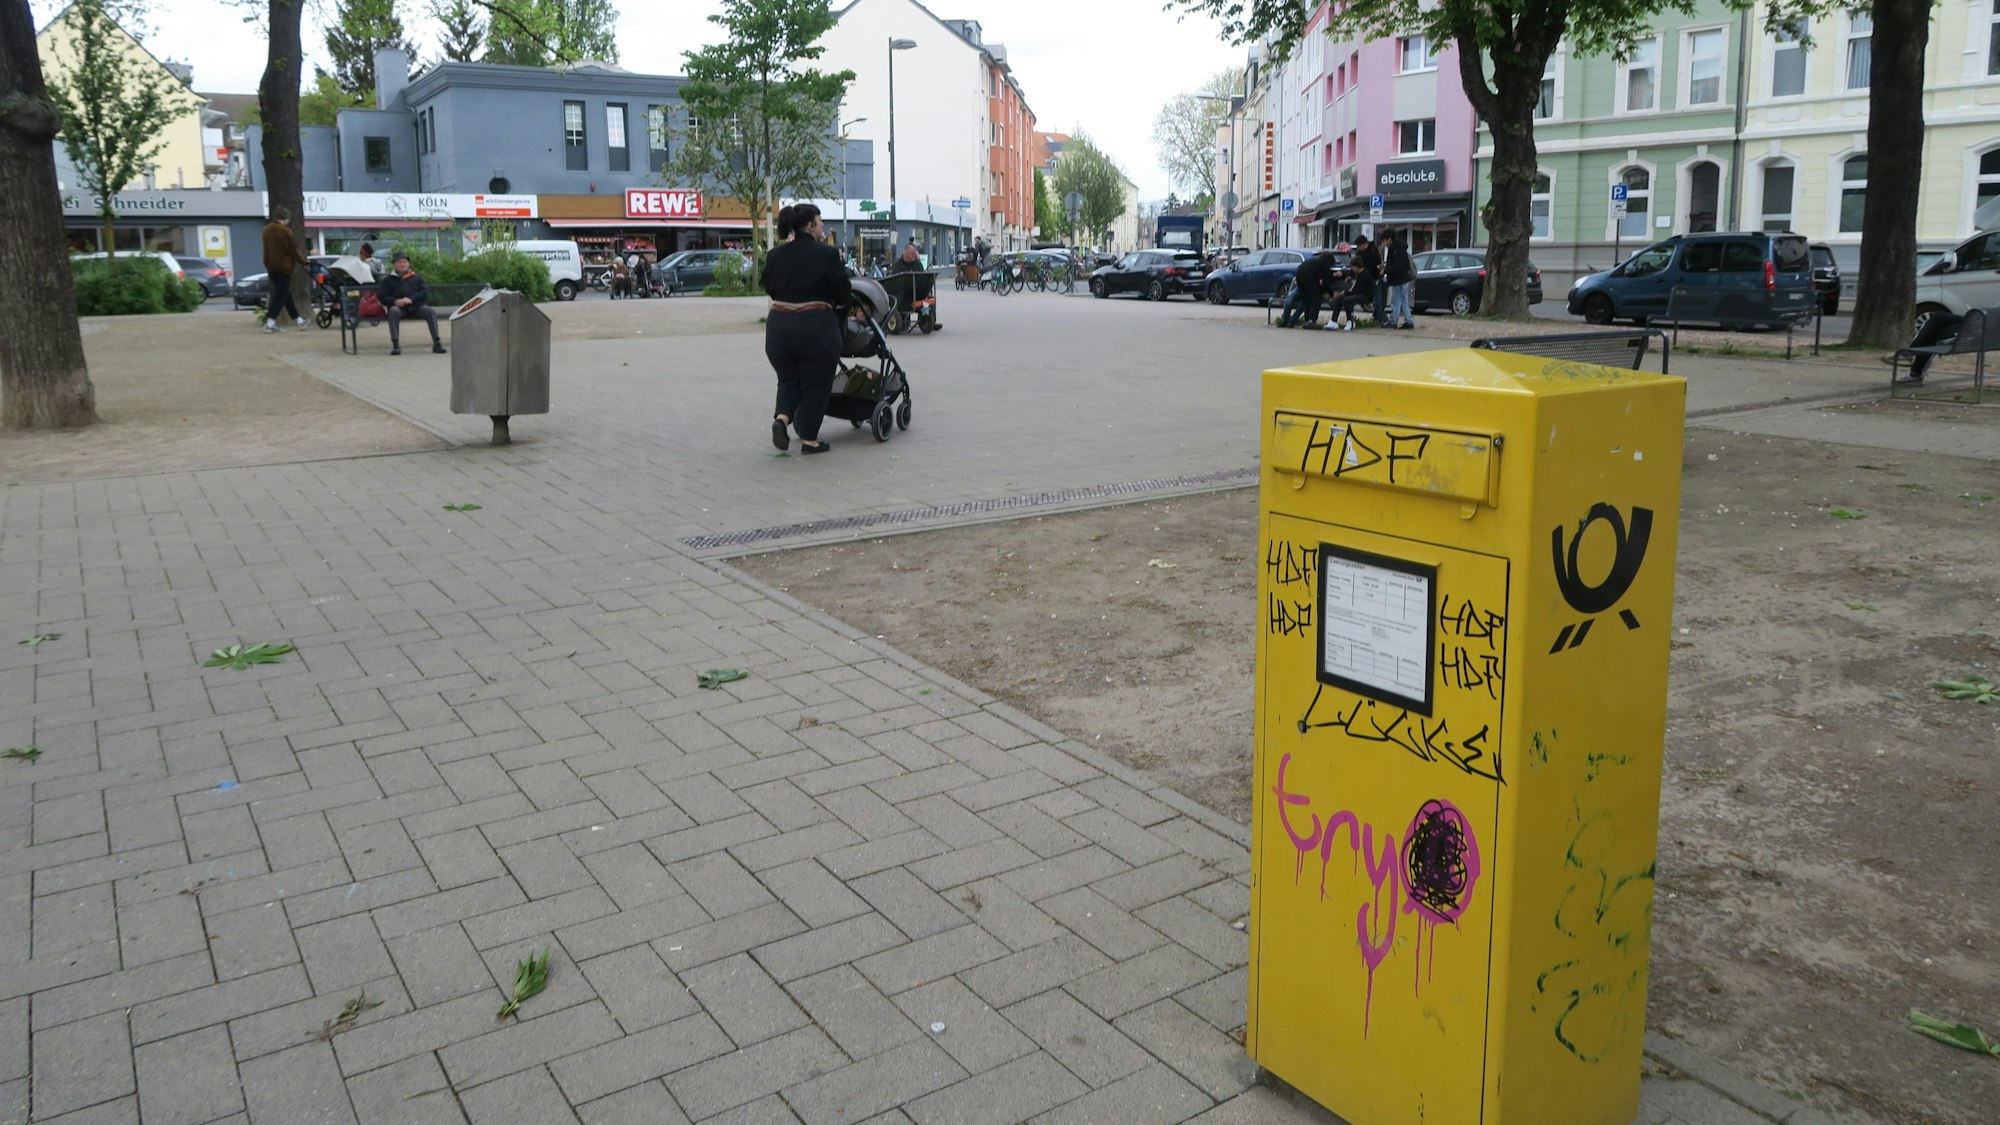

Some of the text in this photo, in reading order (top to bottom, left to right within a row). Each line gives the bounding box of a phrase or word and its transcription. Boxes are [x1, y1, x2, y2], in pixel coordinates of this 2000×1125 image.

[62, 196, 186, 209] ei Shneider
[303, 196, 328, 212] HEAD
[418, 196, 448, 208] KÖLN
[630, 192, 699, 214] REWE
[528, 251, 570, 261] nterprise
